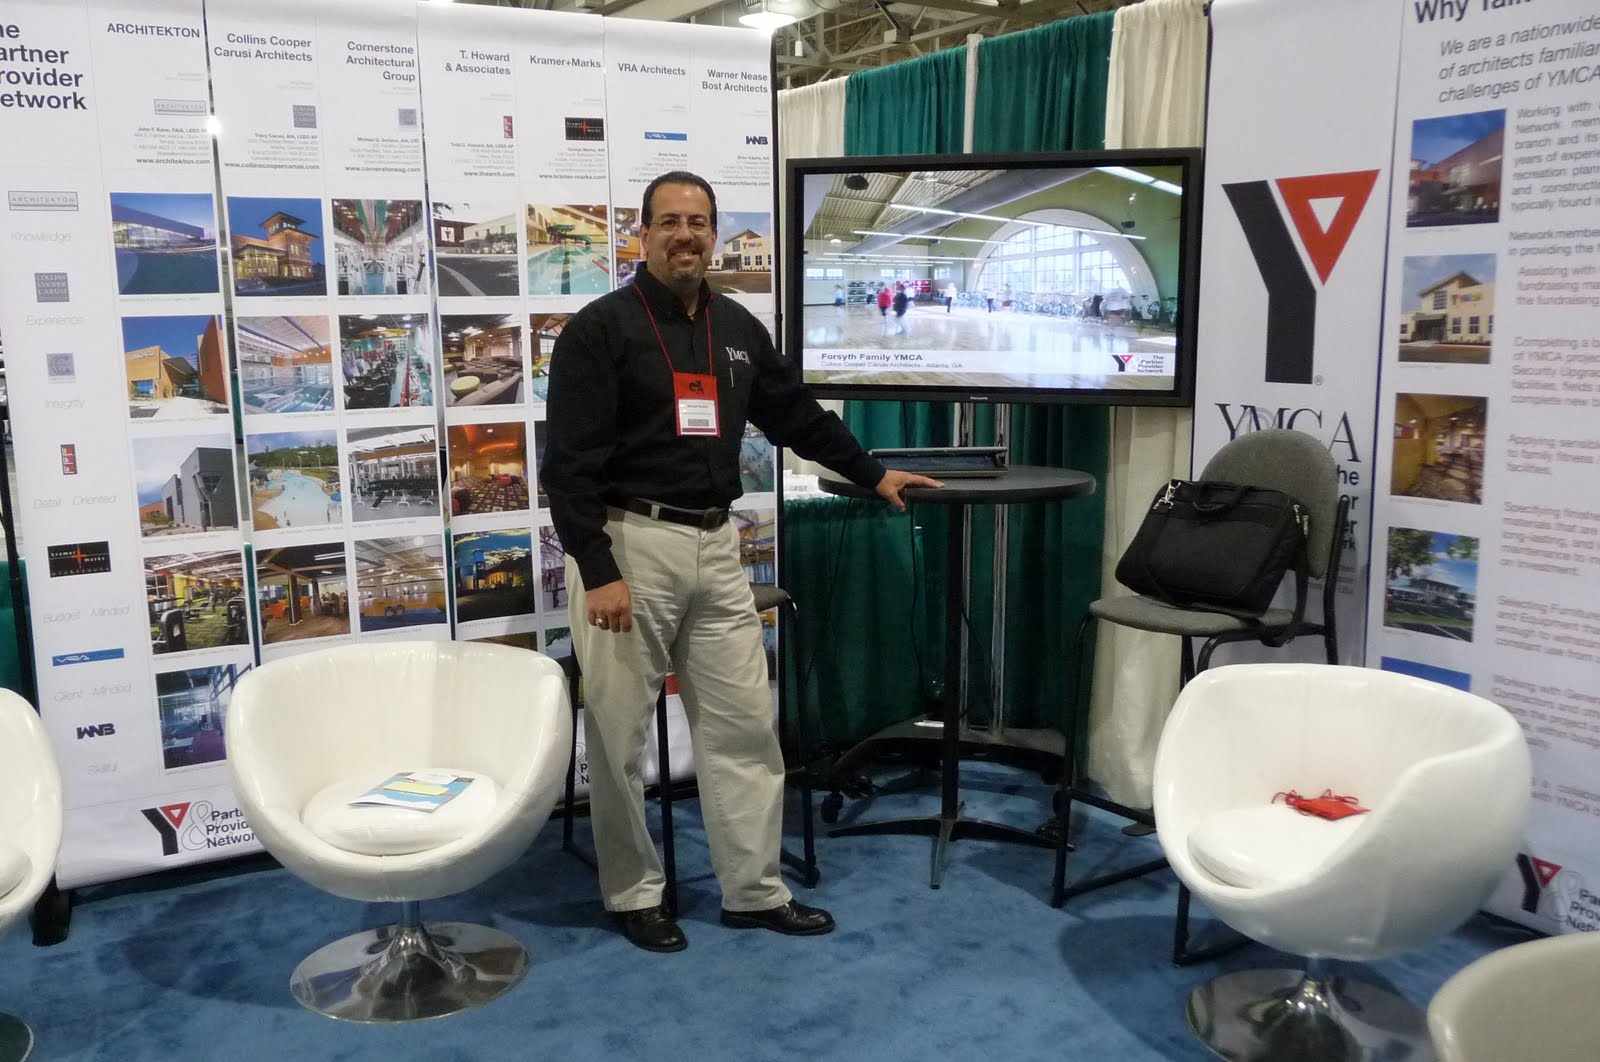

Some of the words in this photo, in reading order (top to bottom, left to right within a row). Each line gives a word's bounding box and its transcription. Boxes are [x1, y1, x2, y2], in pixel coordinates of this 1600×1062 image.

[107, 23, 200, 38] ARCHITEKTON
[1440, 40, 1464, 56] We
[1467, 36, 1491, 51] are
[1495, 34, 1505, 46] a
[1510, 14, 1600, 44] nationwide
[227, 33, 267, 45] Collins
[269, 35, 312, 48] Cooper
[0, 45, 69, 64] artner
[214, 46, 251, 58] Carusi
[254, 49, 313, 62] Architects
[346, 41, 414, 55] Cornerstone
[346, 55, 415, 68] Architectural
[459, 50, 468, 59] T.
[471, 50, 510, 62] Howard
[530, 55, 601, 68] Kramer+Marks
[1438, 62, 1456, 80] of
[1457, 53, 1534, 77] architects
[1538, 41, 1600, 64] familiar
[445, 62, 453, 72] &
[455, 63, 511, 75] Associates
[618, 63, 638, 73] VRA
[640, 64, 686, 76] Architects
[707, 69, 738, 80] Warner
[740, 71, 768, 81] Nease
[0, 67, 83, 87] rovider
[382, 70, 416, 83] Group
[702, 81, 722, 91] Bost
[724, 82, 768, 93] Architects
[1438, 79, 1520, 103] challenges
[1524, 72, 1543, 91] of
[0, 90, 87, 110] etwork
[136, 157, 210, 165] www.architekton.com
[10, 231, 72, 244] Knowledge
[26, 314, 85, 326] Experience
[725, 346, 750, 365] YMCA
[821, 353, 857, 361] Forsyth
[859, 353, 891, 361] Family
[1336, 464, 1360, 486] he
